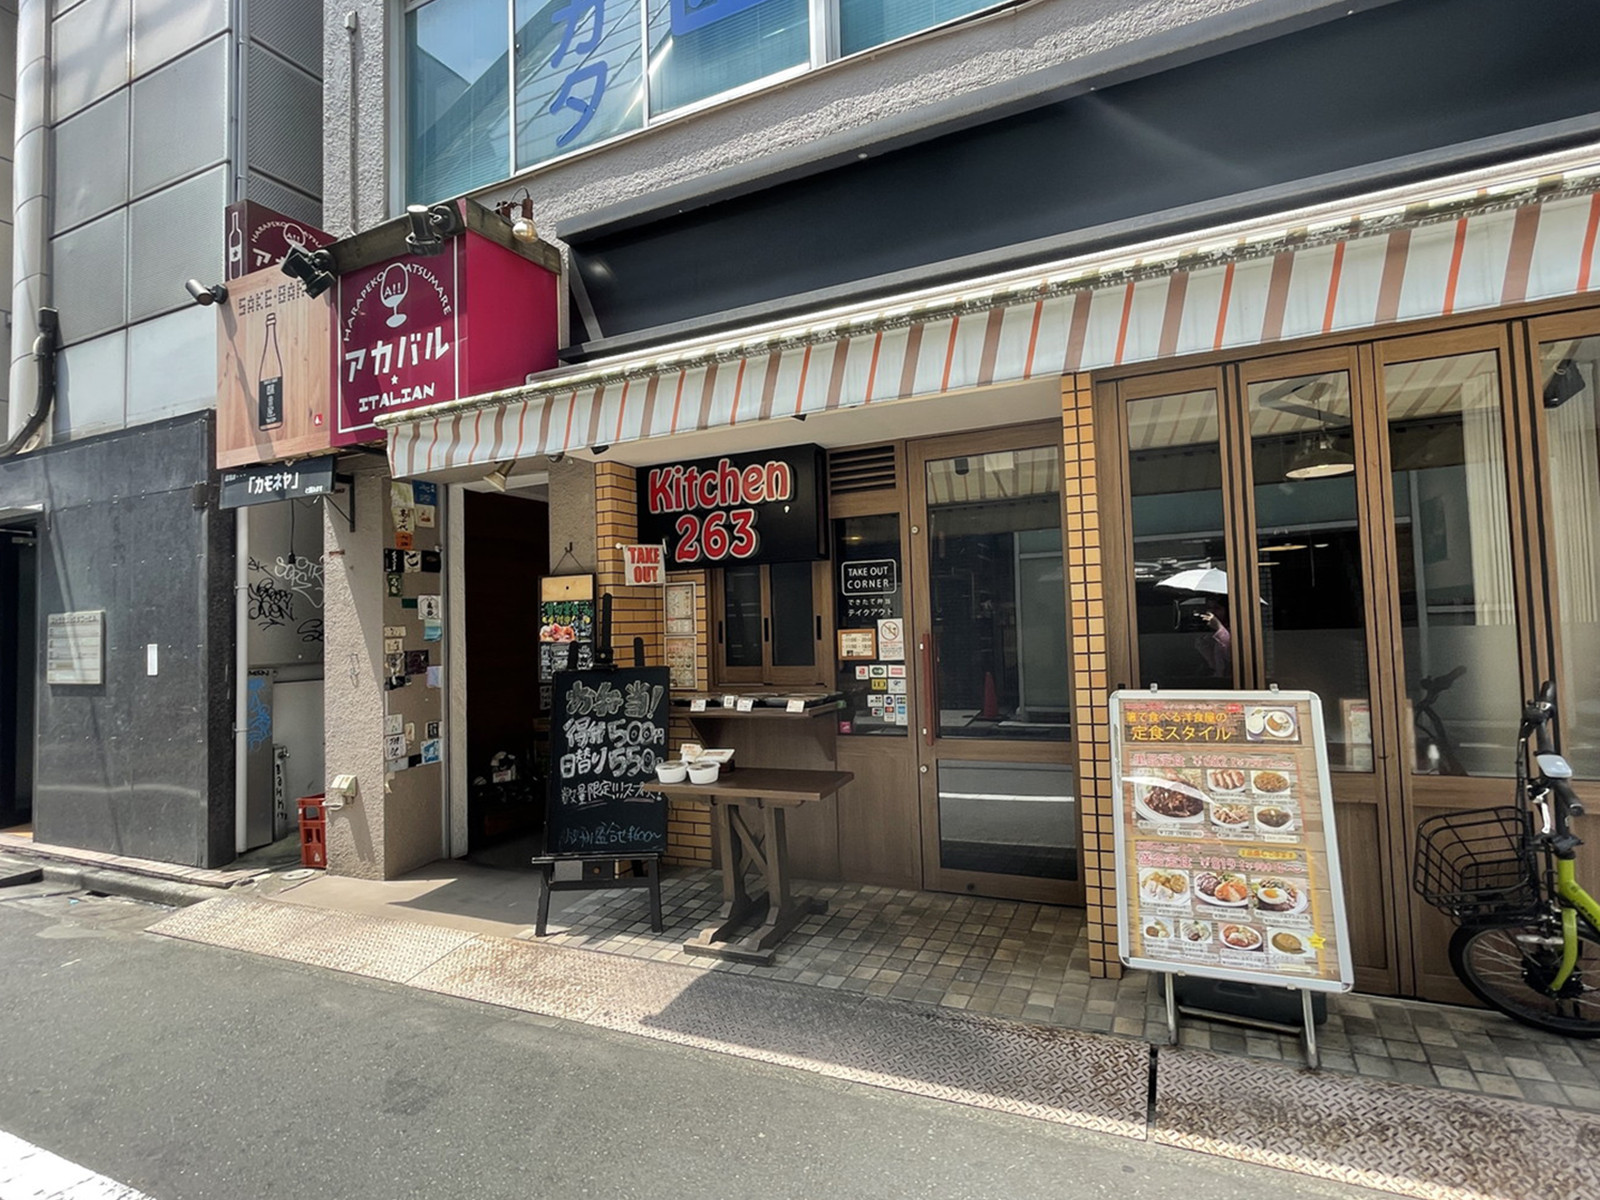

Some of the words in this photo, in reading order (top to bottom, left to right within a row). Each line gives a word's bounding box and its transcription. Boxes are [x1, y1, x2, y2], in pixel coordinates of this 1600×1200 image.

[343, 271, 386, 342] HARAPEKO
[405, 263, 451, 315] ATSUMARE
[345, 326, 450, 383] アカバル
[358, 382, 436, 413] ITALIAN
[649, 458, 791, 514] Kitchen
[675, 508, 757, 563] 263
[627, 547, 660, 564] TAKE
[633, 566, 659, 584] OUT
[848, 567, 868, 576] TAKE
[870, 566, 889, 576] OUT
[847, 578, 889, 589] CORNER
[848, 608, 893, 617] テイクアウト
[1131, 725, 1232, 741] 定食スタイル
